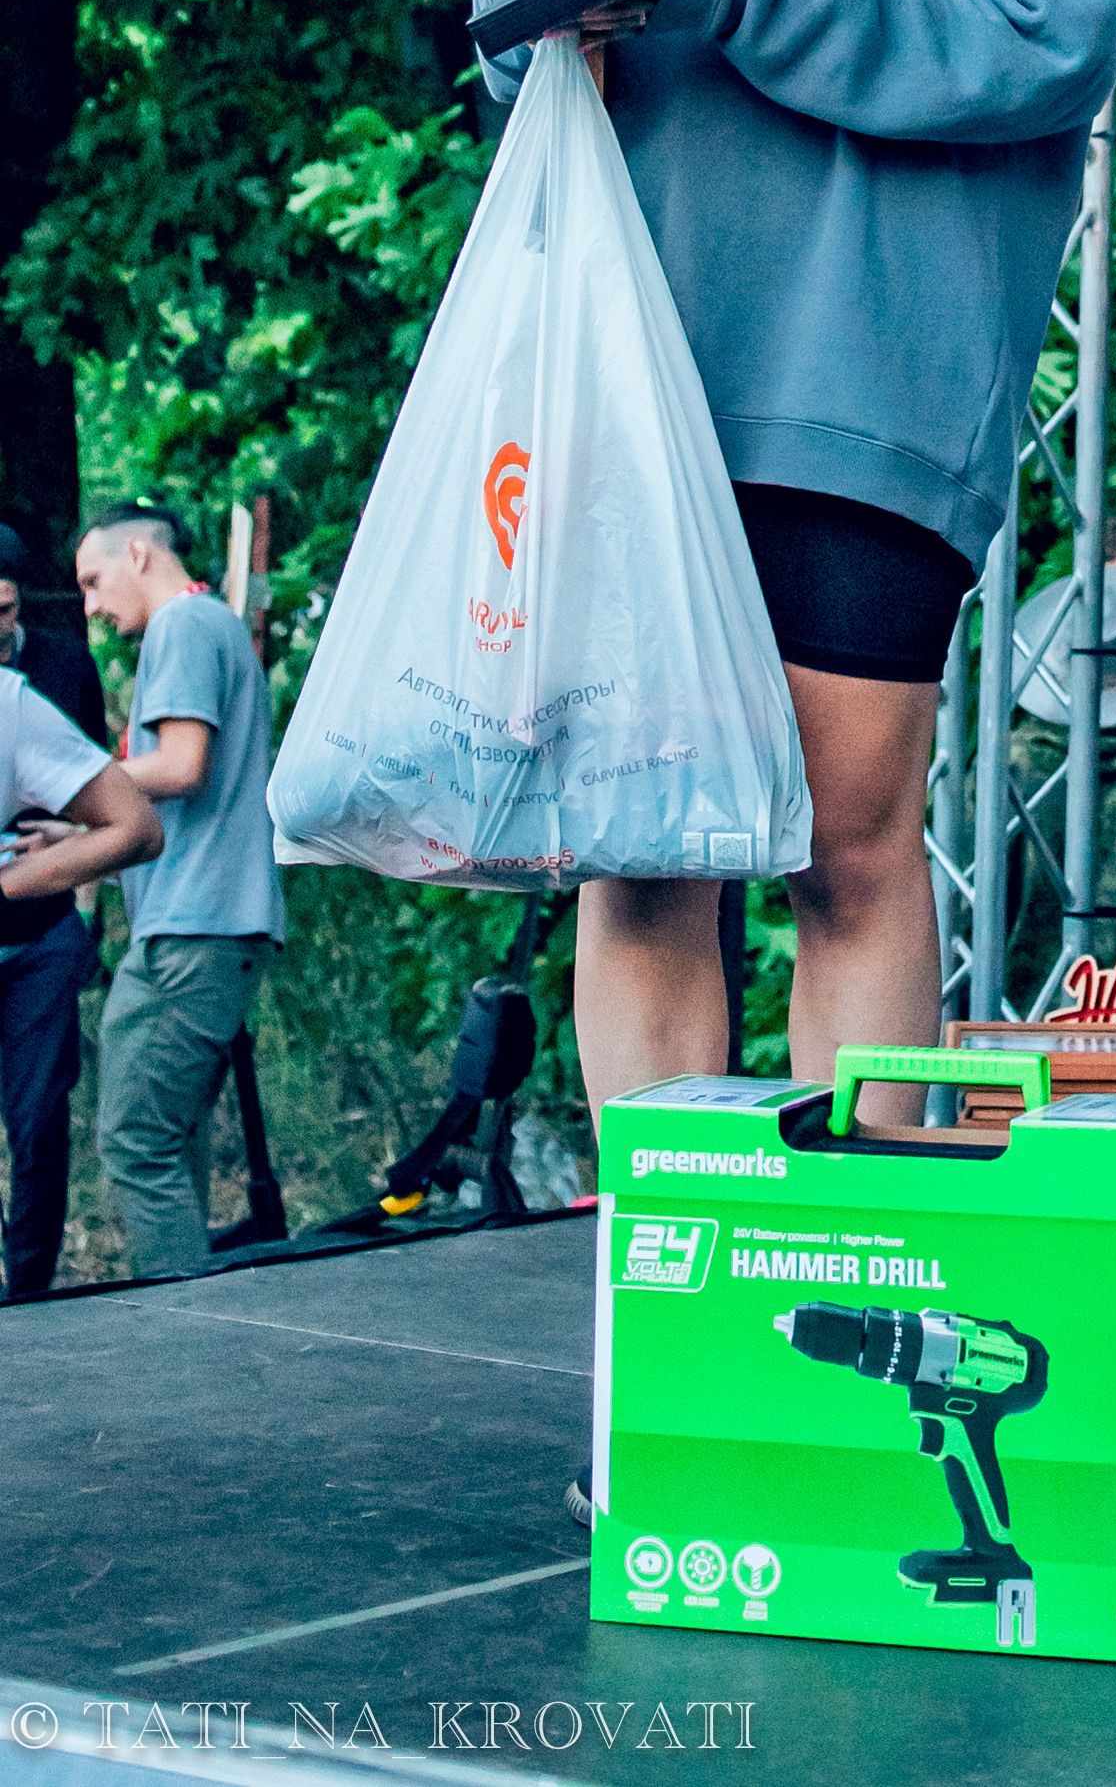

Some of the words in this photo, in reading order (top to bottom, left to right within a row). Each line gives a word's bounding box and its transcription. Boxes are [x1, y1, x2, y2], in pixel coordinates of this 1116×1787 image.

[324, 729, 357, 754] LUZAR
[374, 754, 424, 780] AIRLINE
[581, 760, 644, 786] CARVILLE
[647, 746, 699, 770] RACING
[631, 1147, 788, 1179] greenworks
[628, 1223, 700, 1263] 24
[733, 1227, 752, 1239] 24V
[788, 1231, 830, 1244] powered
[841, 1233, 873, 1247] Higher
[874, 1236, 905, 1247] Power
[626, 1259, 682, 1275] VOLT
[731, 1248, 861, 1286] HAMMER
[867, 1255, 947, 1290] DRILL
